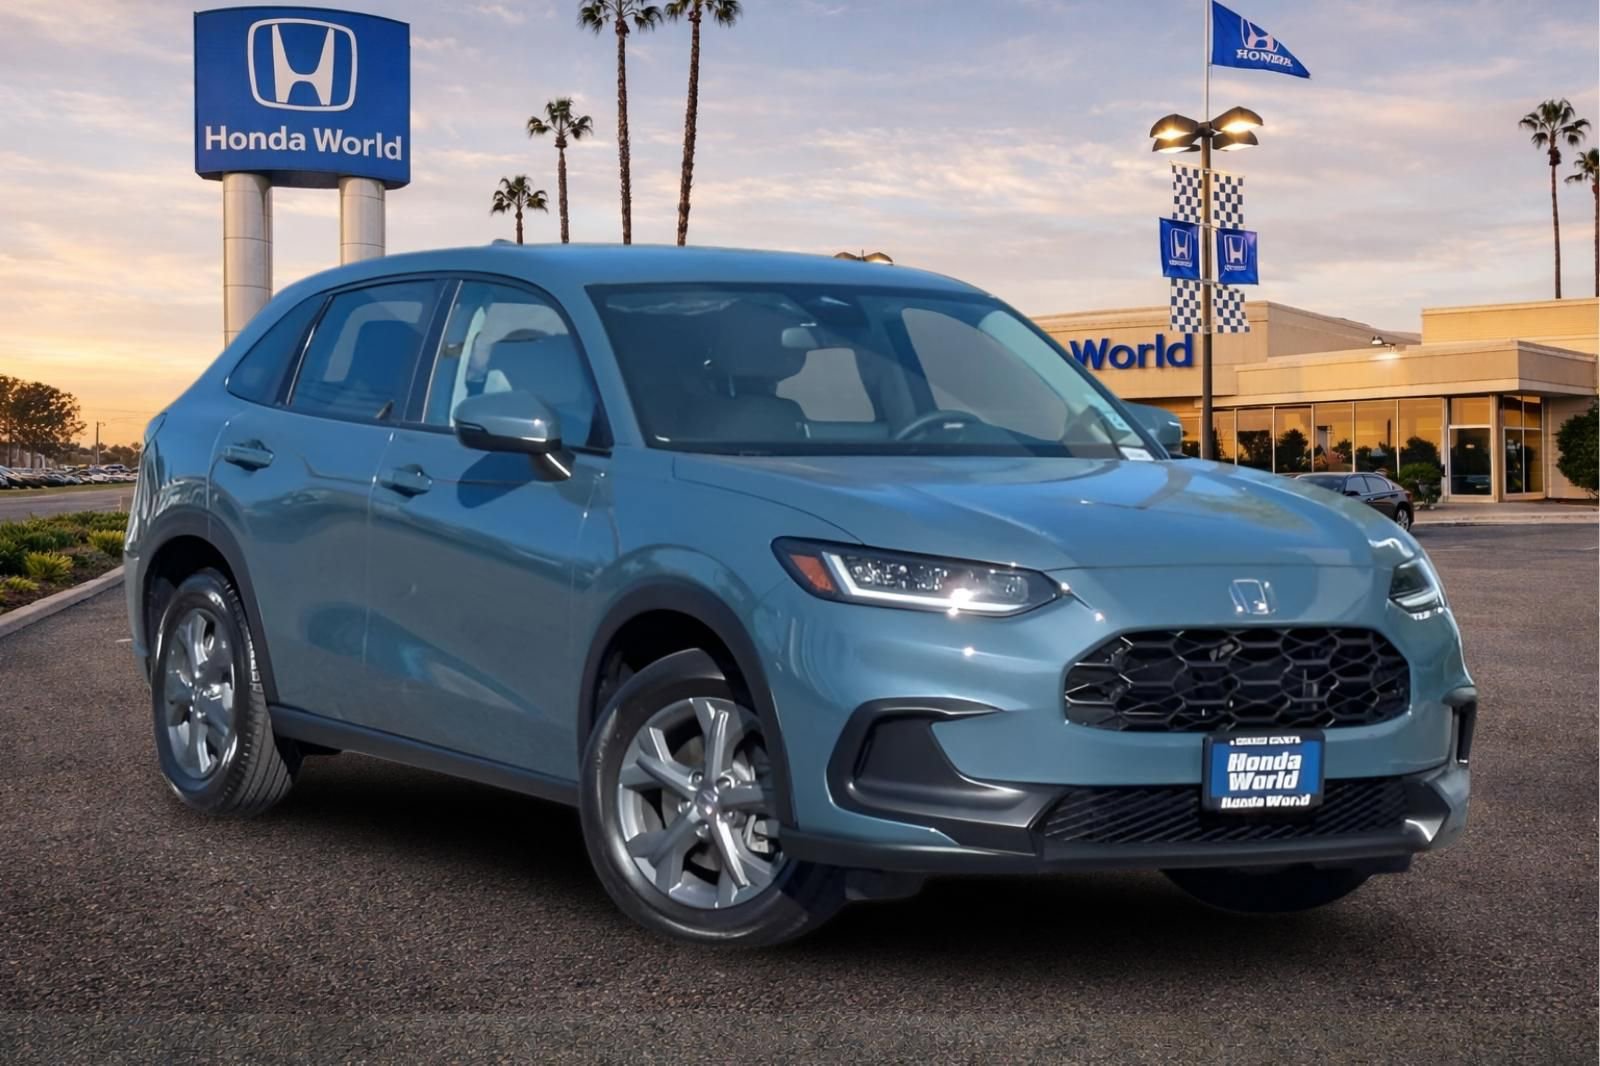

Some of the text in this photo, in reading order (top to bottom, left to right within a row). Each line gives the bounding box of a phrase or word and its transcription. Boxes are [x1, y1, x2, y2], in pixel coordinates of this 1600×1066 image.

[205, 125, 402, 160] Honda World
[1069, 333, 1193, 370] World
[1227, 752, 1302, 772] Honda
[1229, 770, 1299, 791] World
